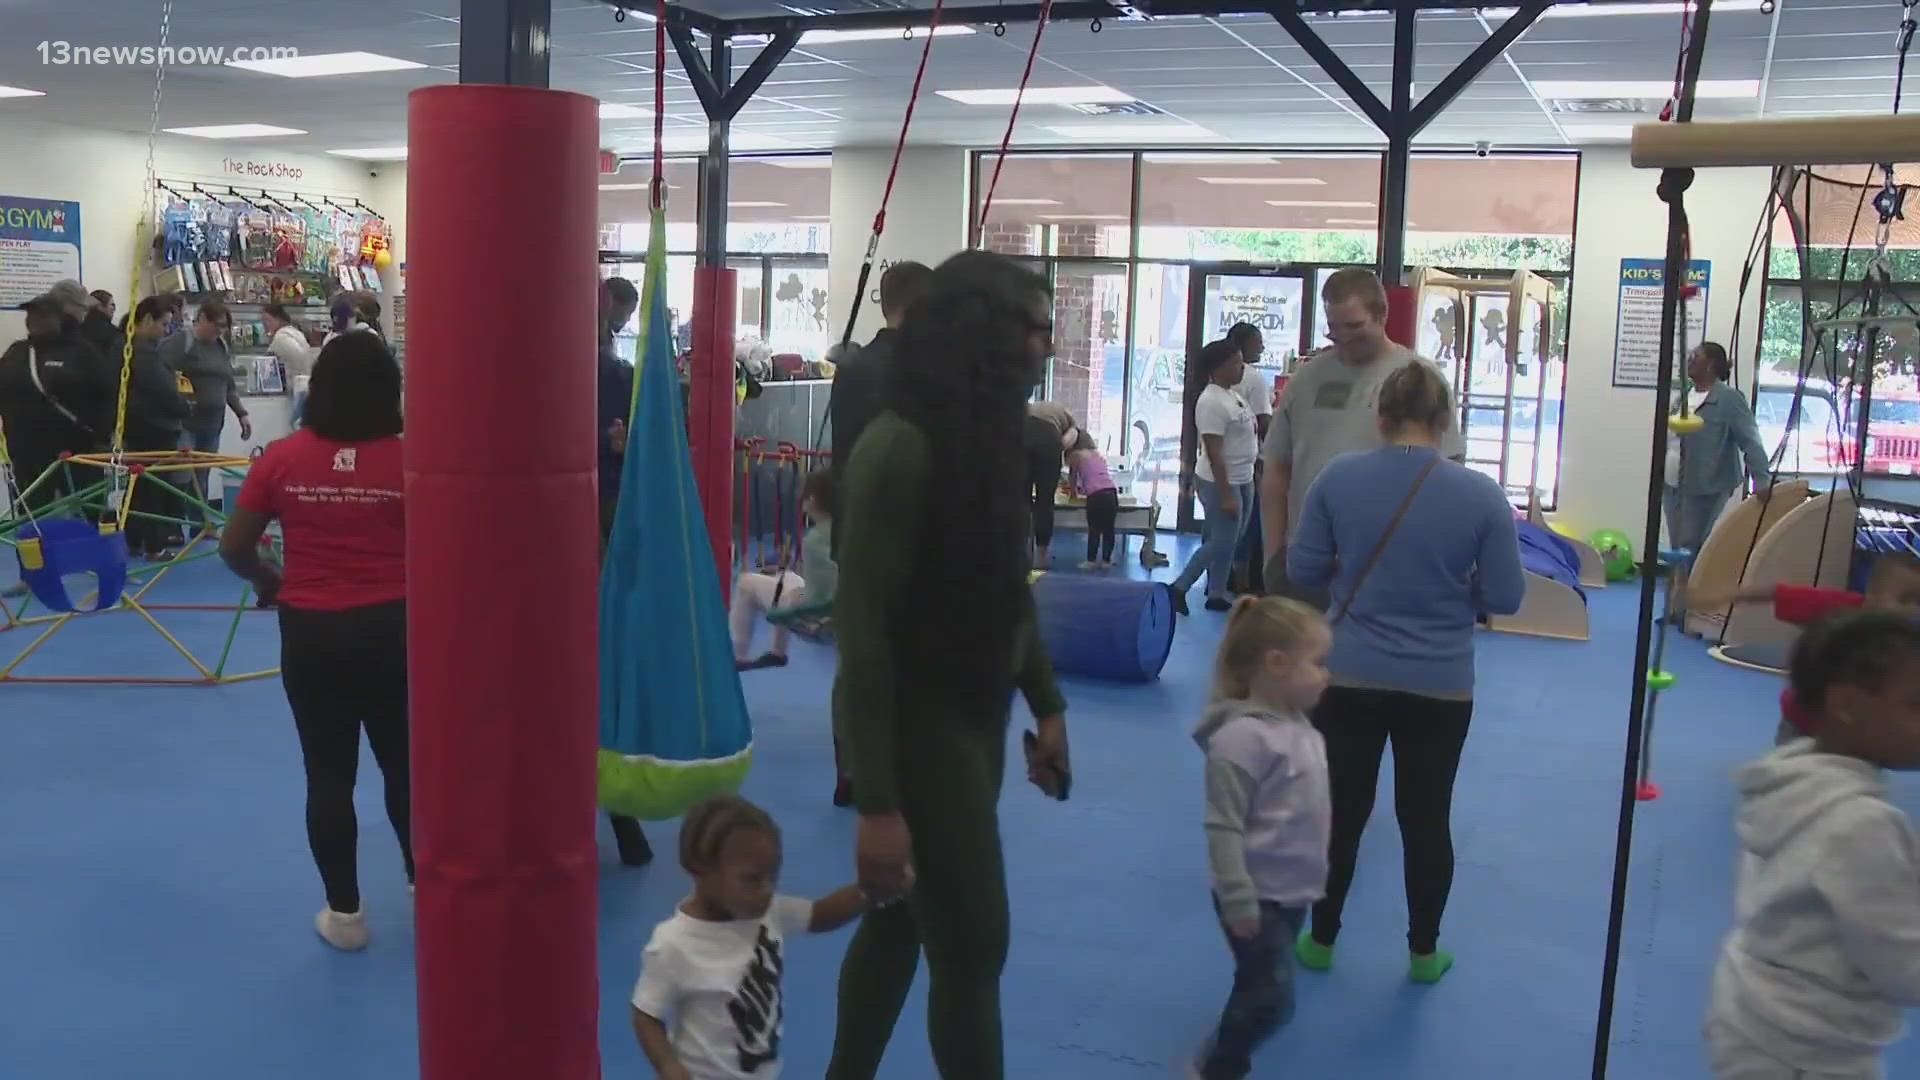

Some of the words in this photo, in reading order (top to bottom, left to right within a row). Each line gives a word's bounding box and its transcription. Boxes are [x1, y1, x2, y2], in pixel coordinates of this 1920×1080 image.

[222, 157, 244, 174] The
[7, 207, 53, 230] GYM
[0, 240, 14, 248] PEN
[15, 240, 31, 249] PLAY
[1622, 268, 1663, 280] KID'S
